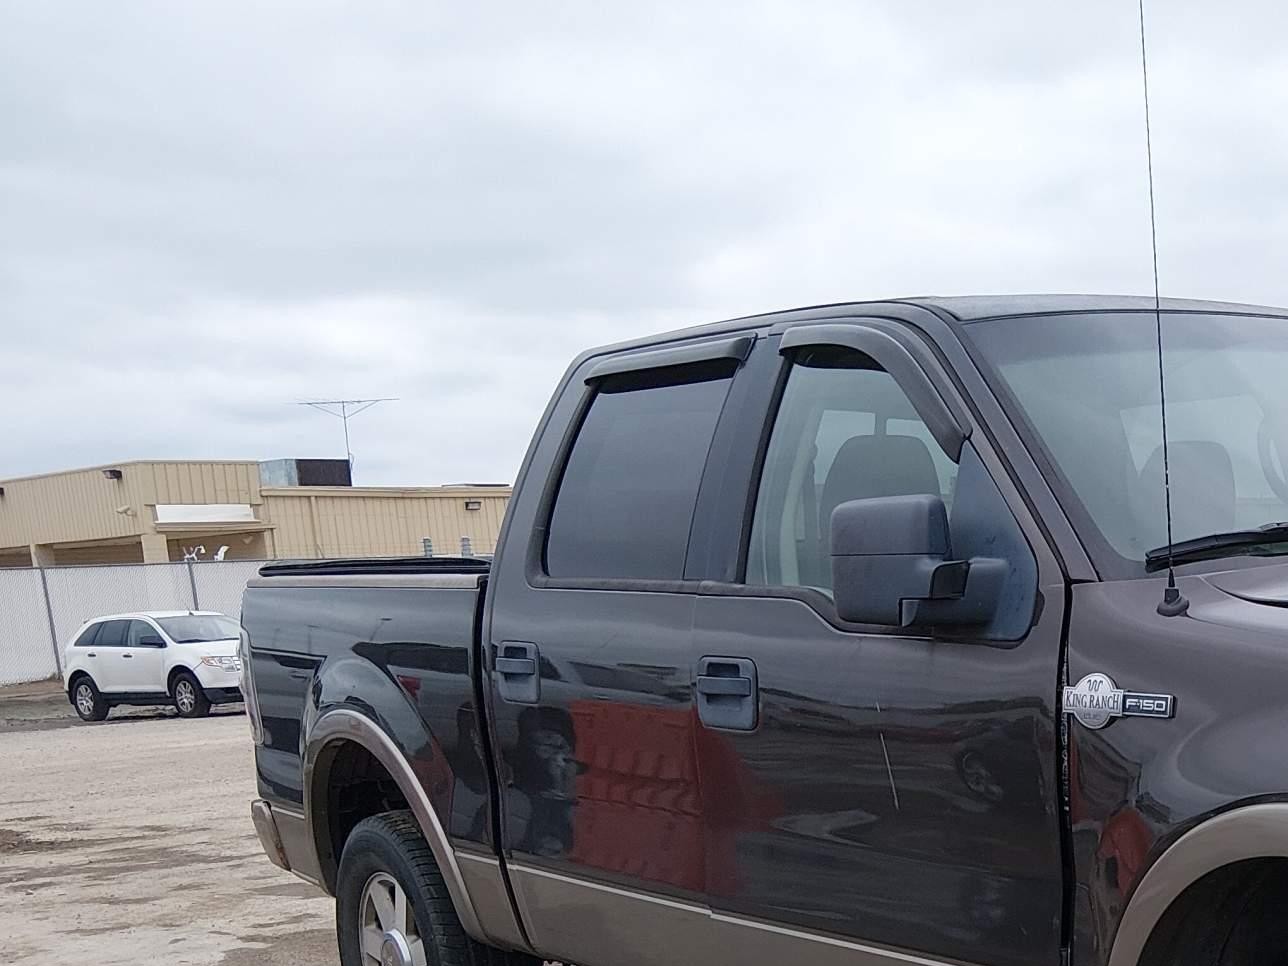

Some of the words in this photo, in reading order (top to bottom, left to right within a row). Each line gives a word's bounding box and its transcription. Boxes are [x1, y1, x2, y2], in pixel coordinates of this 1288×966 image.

[1065, 691, 1087, 709] KING
[1089, 693, 1120, 710] RANCH
[1125, 698, 1166, 712] F-150
